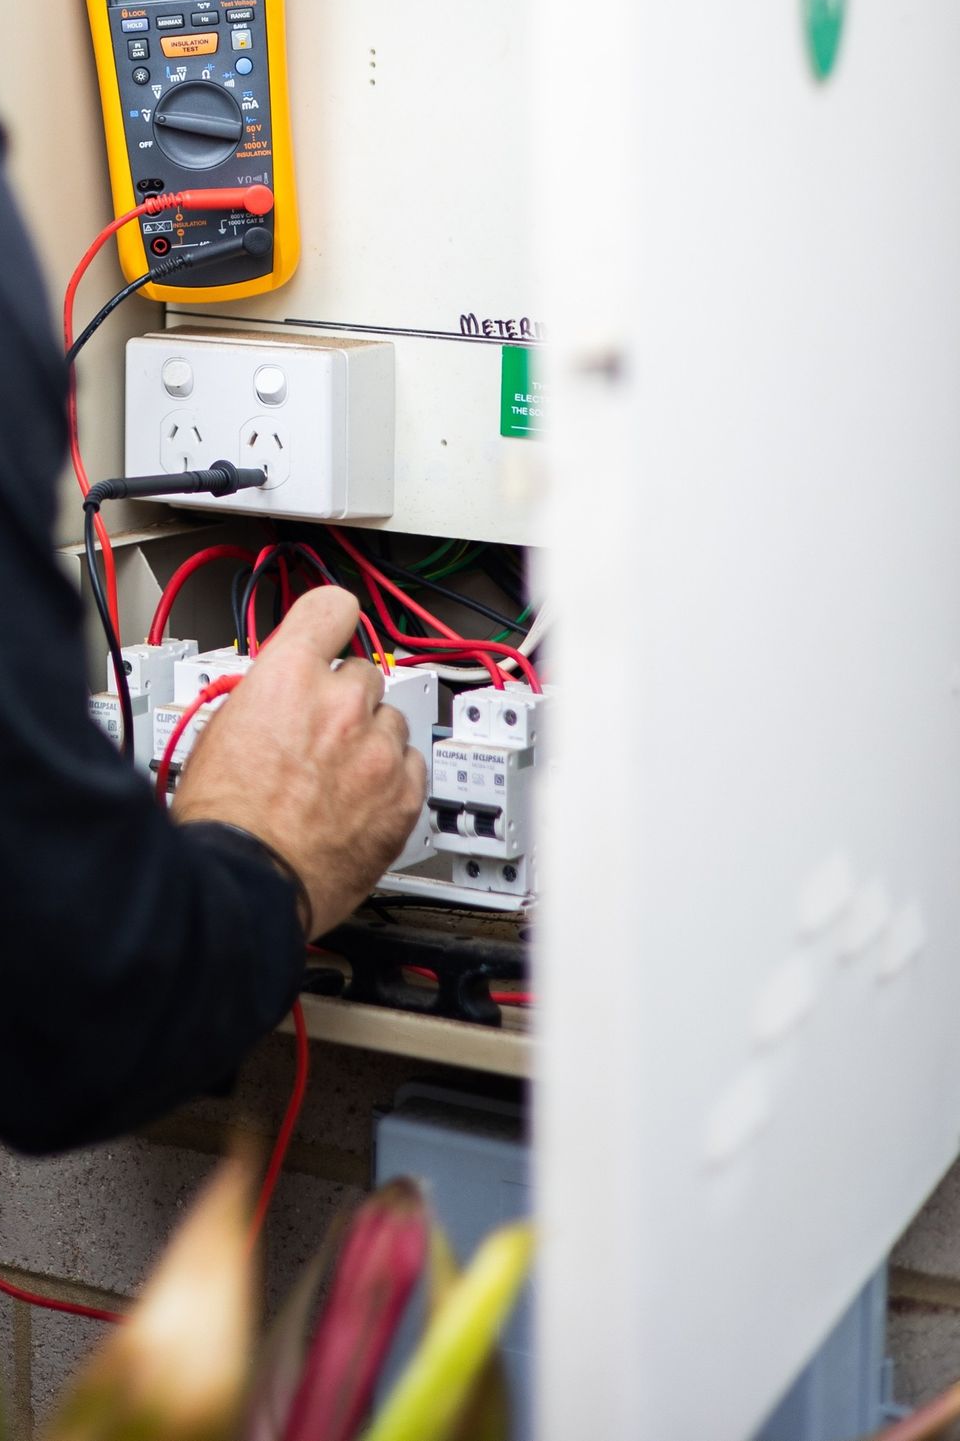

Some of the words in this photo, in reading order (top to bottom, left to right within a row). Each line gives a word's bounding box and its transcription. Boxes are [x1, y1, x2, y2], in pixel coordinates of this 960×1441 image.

[170, 39, 209, 47] INSULATION
[170, 71, 187, 82] mV
[241, 100, 259, 110] mA
[236, 150, 271, 158] INSULATION
[172, 220, 207, 229] INSULATION
[511, 406, 528, 415] THE
[441, 750, 467, 761] CLIPSAL
[478, 753, 504, 764] CLIPSAL
